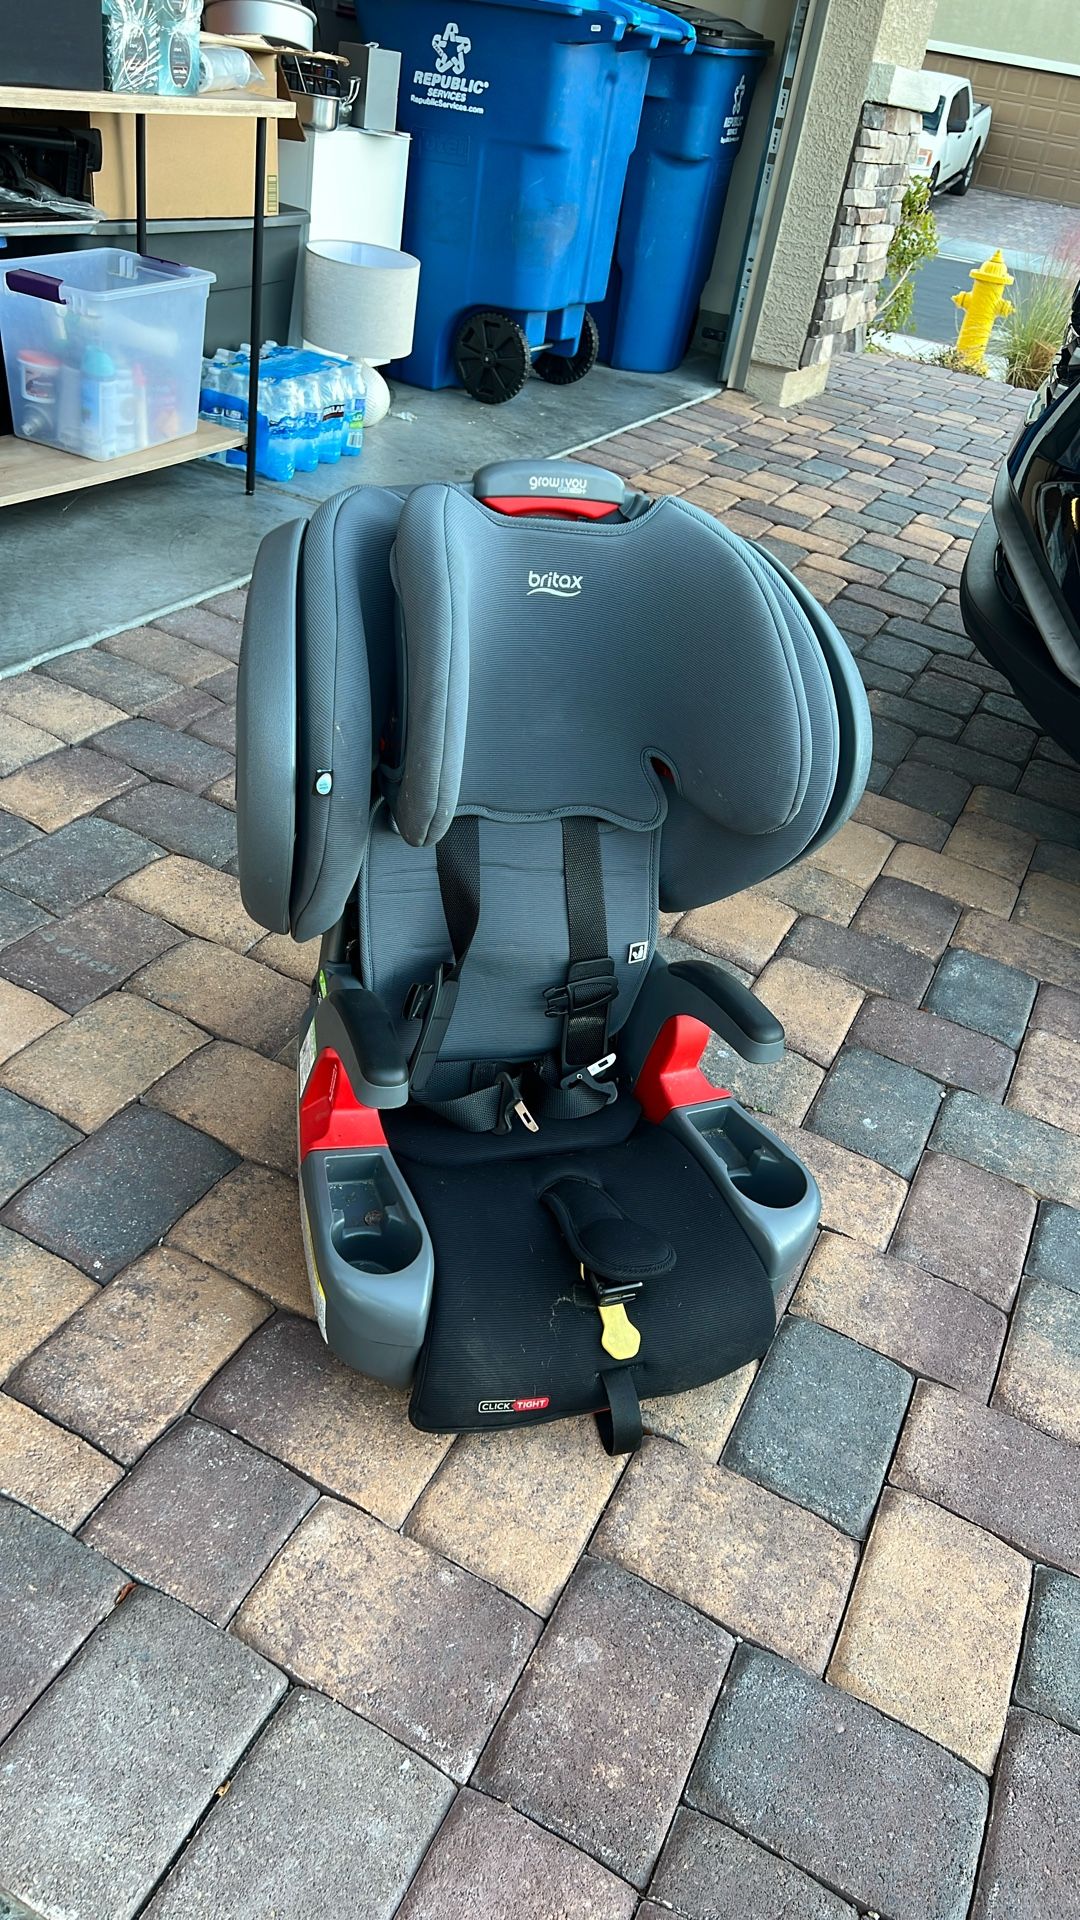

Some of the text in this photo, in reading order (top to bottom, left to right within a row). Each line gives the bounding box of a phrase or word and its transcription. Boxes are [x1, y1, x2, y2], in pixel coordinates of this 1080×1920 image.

[427, 87, 467, 103] SERVICES
[410, 94, 485, 115] RepublicServices.com
[529, 476, 587, 490] grow you
[528, 570, 583, 589] britax
[481, 1399, 546, 1411] CLICK TIGHT
